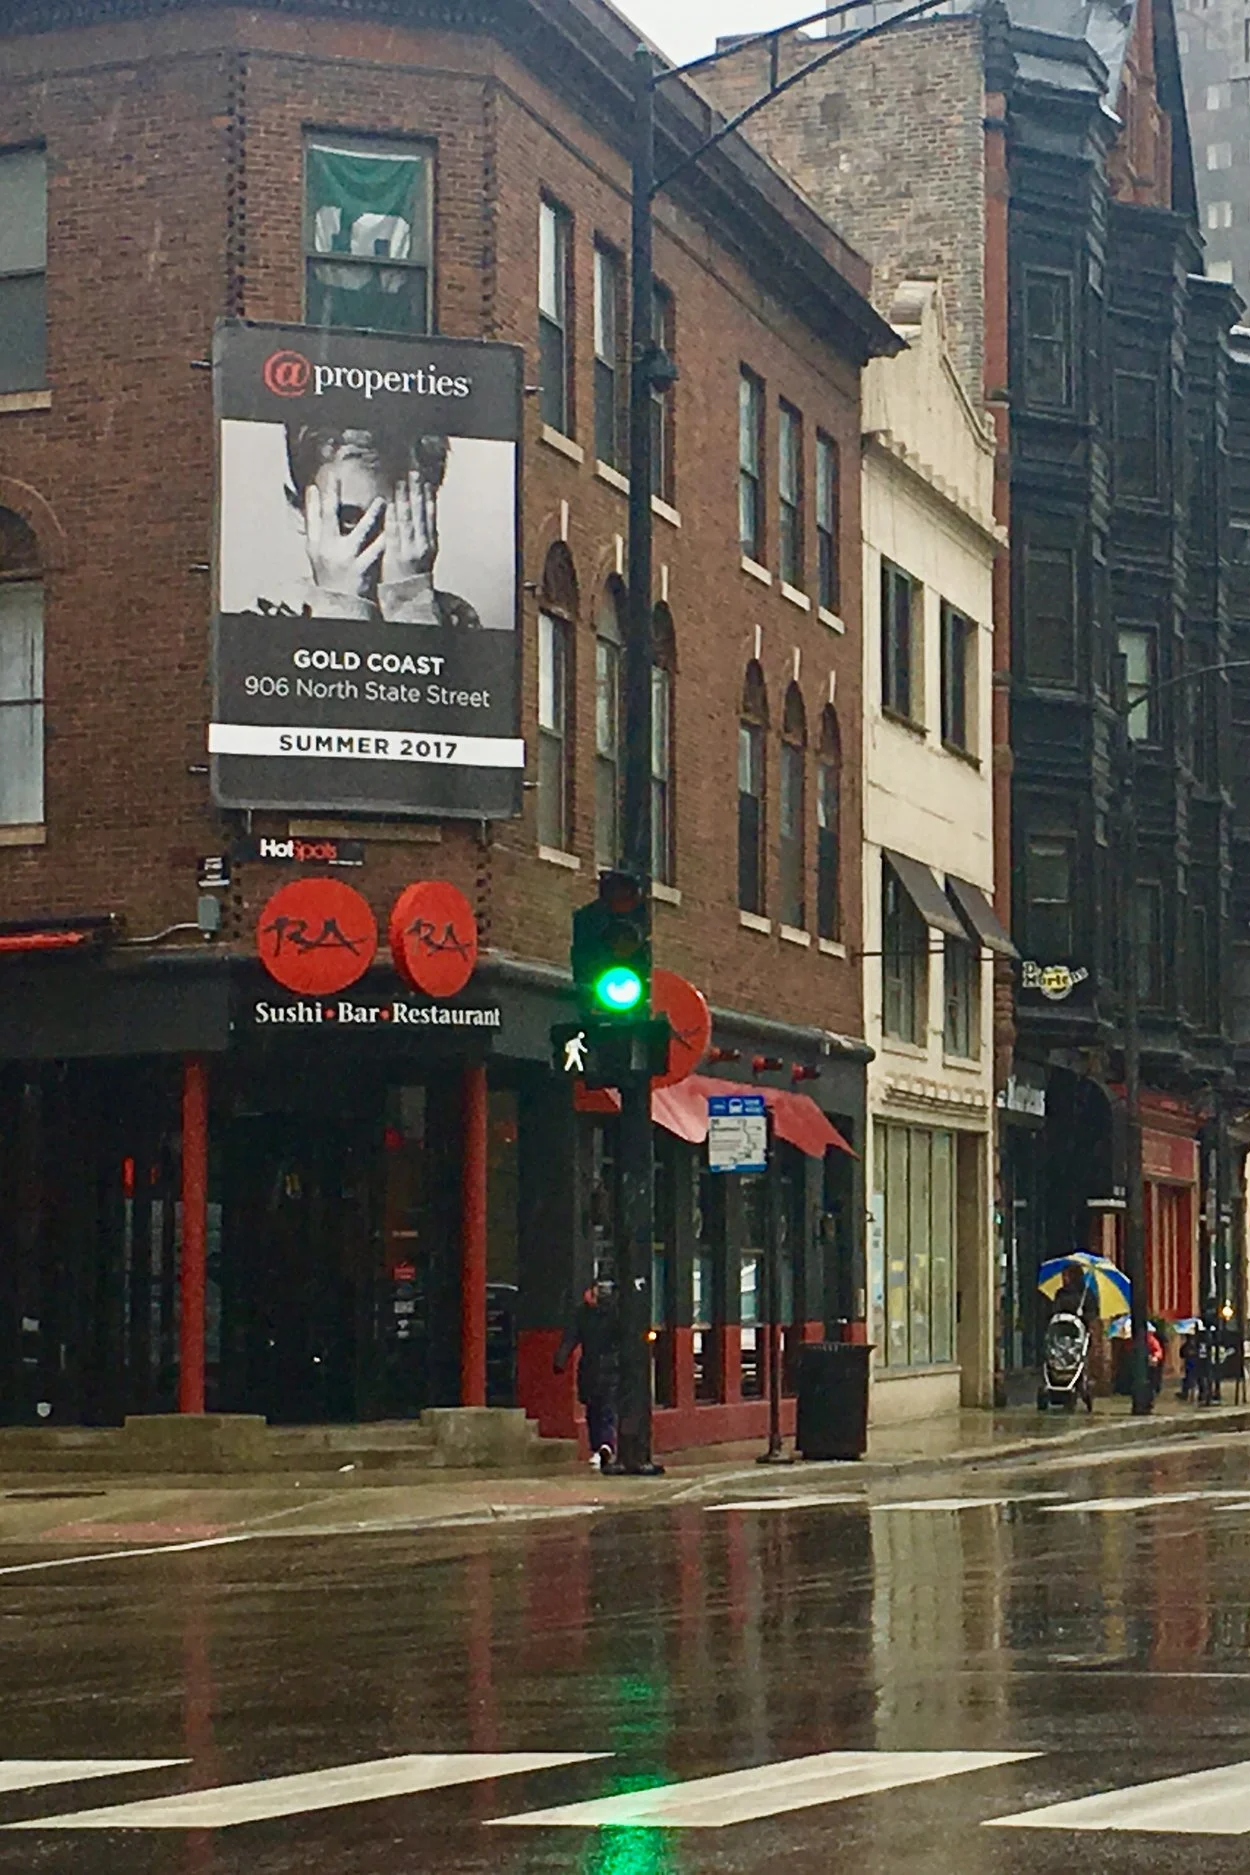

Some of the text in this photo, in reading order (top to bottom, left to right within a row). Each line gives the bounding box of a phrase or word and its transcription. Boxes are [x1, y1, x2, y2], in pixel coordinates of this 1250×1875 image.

[263, 349, 473, 399] @properties
[293, 650, 445, 676] GOLD COAST
[244, 676, 490, 708] 906 North State Street
[279, 734, 458, 759] SUMMER 2017
[254, 1002, 500, 1026] Sushi Bar Restaurant
